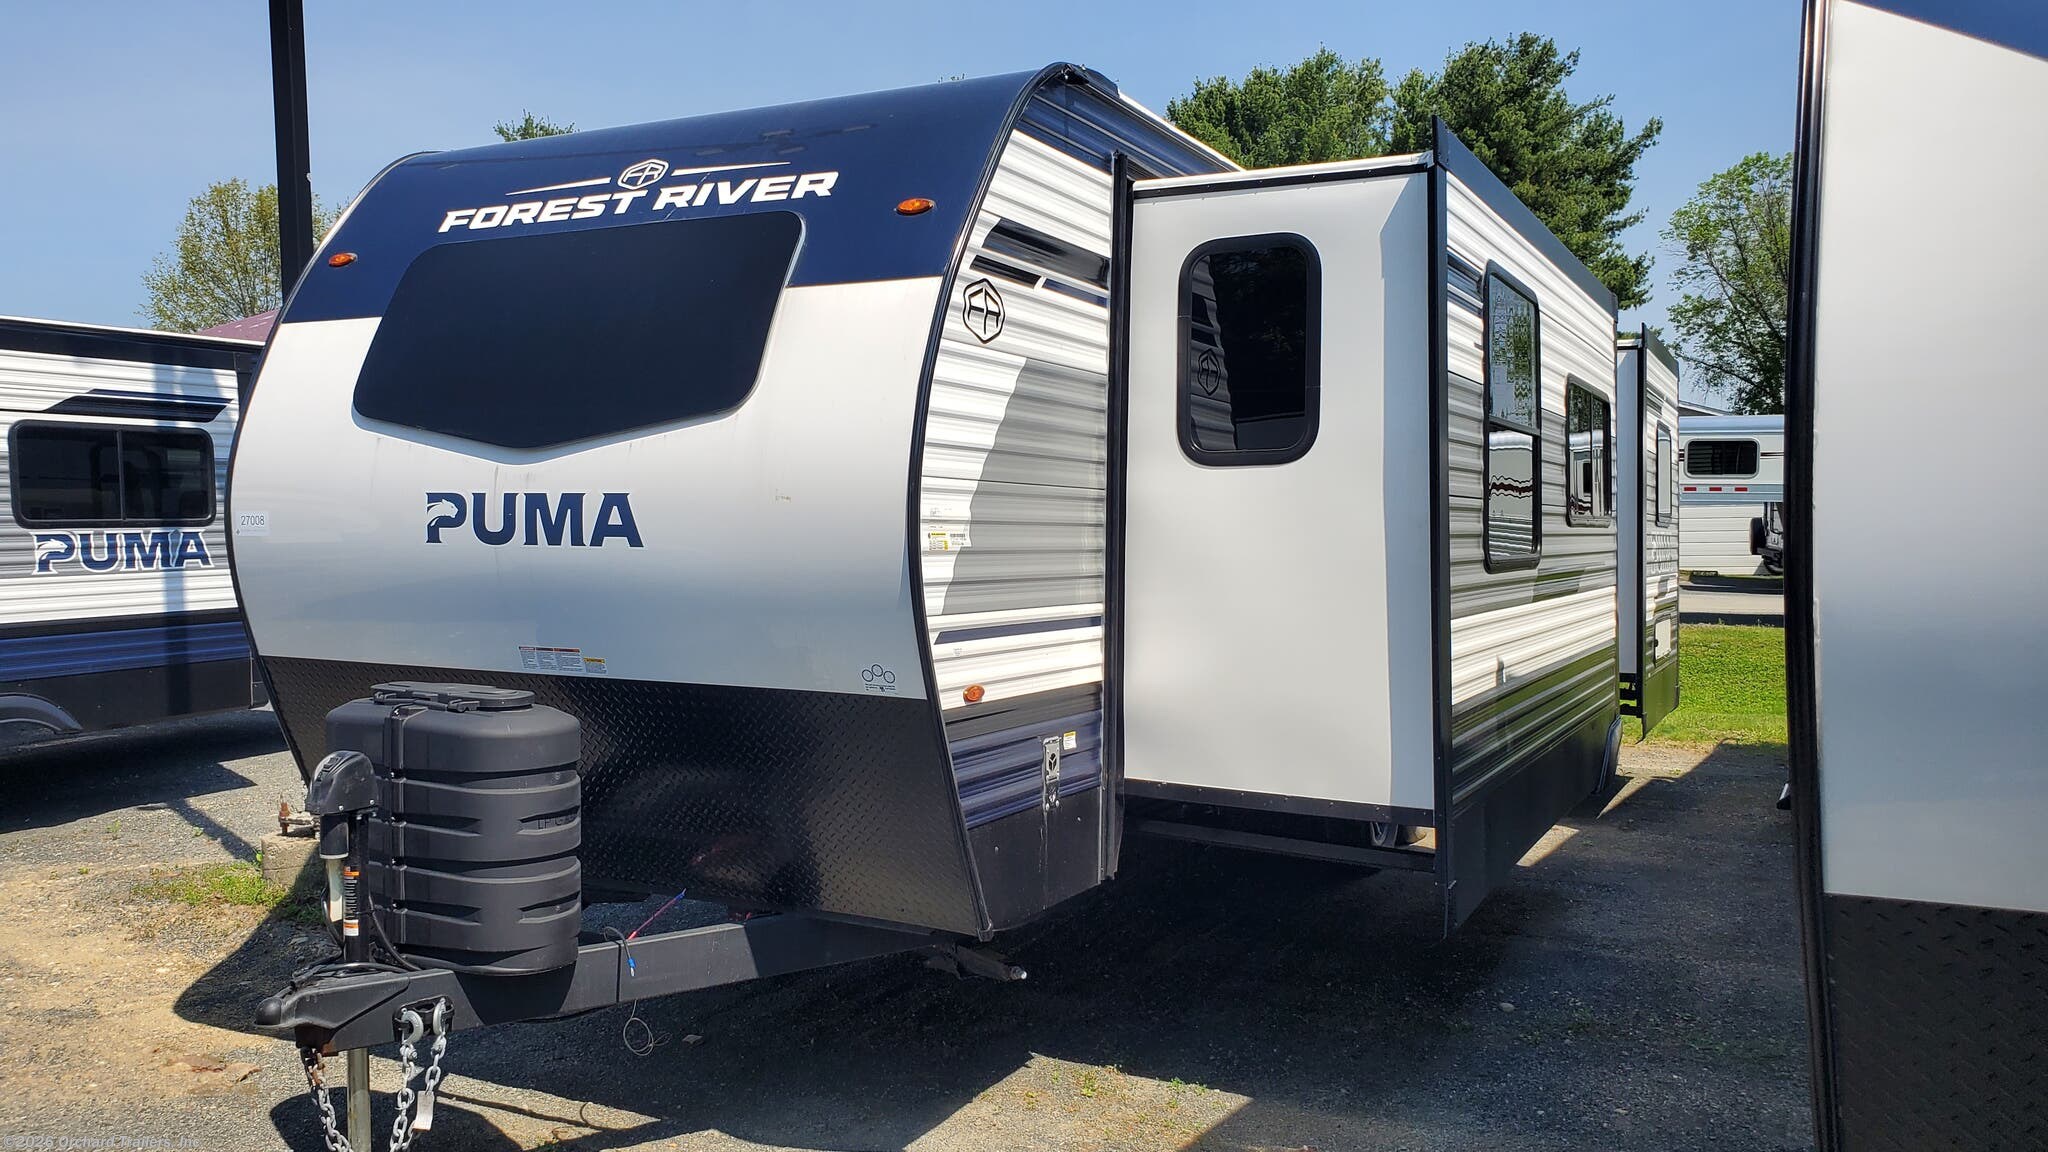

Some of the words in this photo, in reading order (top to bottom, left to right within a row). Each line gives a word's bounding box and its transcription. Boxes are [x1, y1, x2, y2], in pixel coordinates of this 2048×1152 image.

[437, 189, 649, 234] FOREST
[652, 171, 840, 211] RIVER
[240, 515, 265, 526] 27008
[425, 492, 645, 548] PUMA
[29, 531, 216, 575] PUMA
